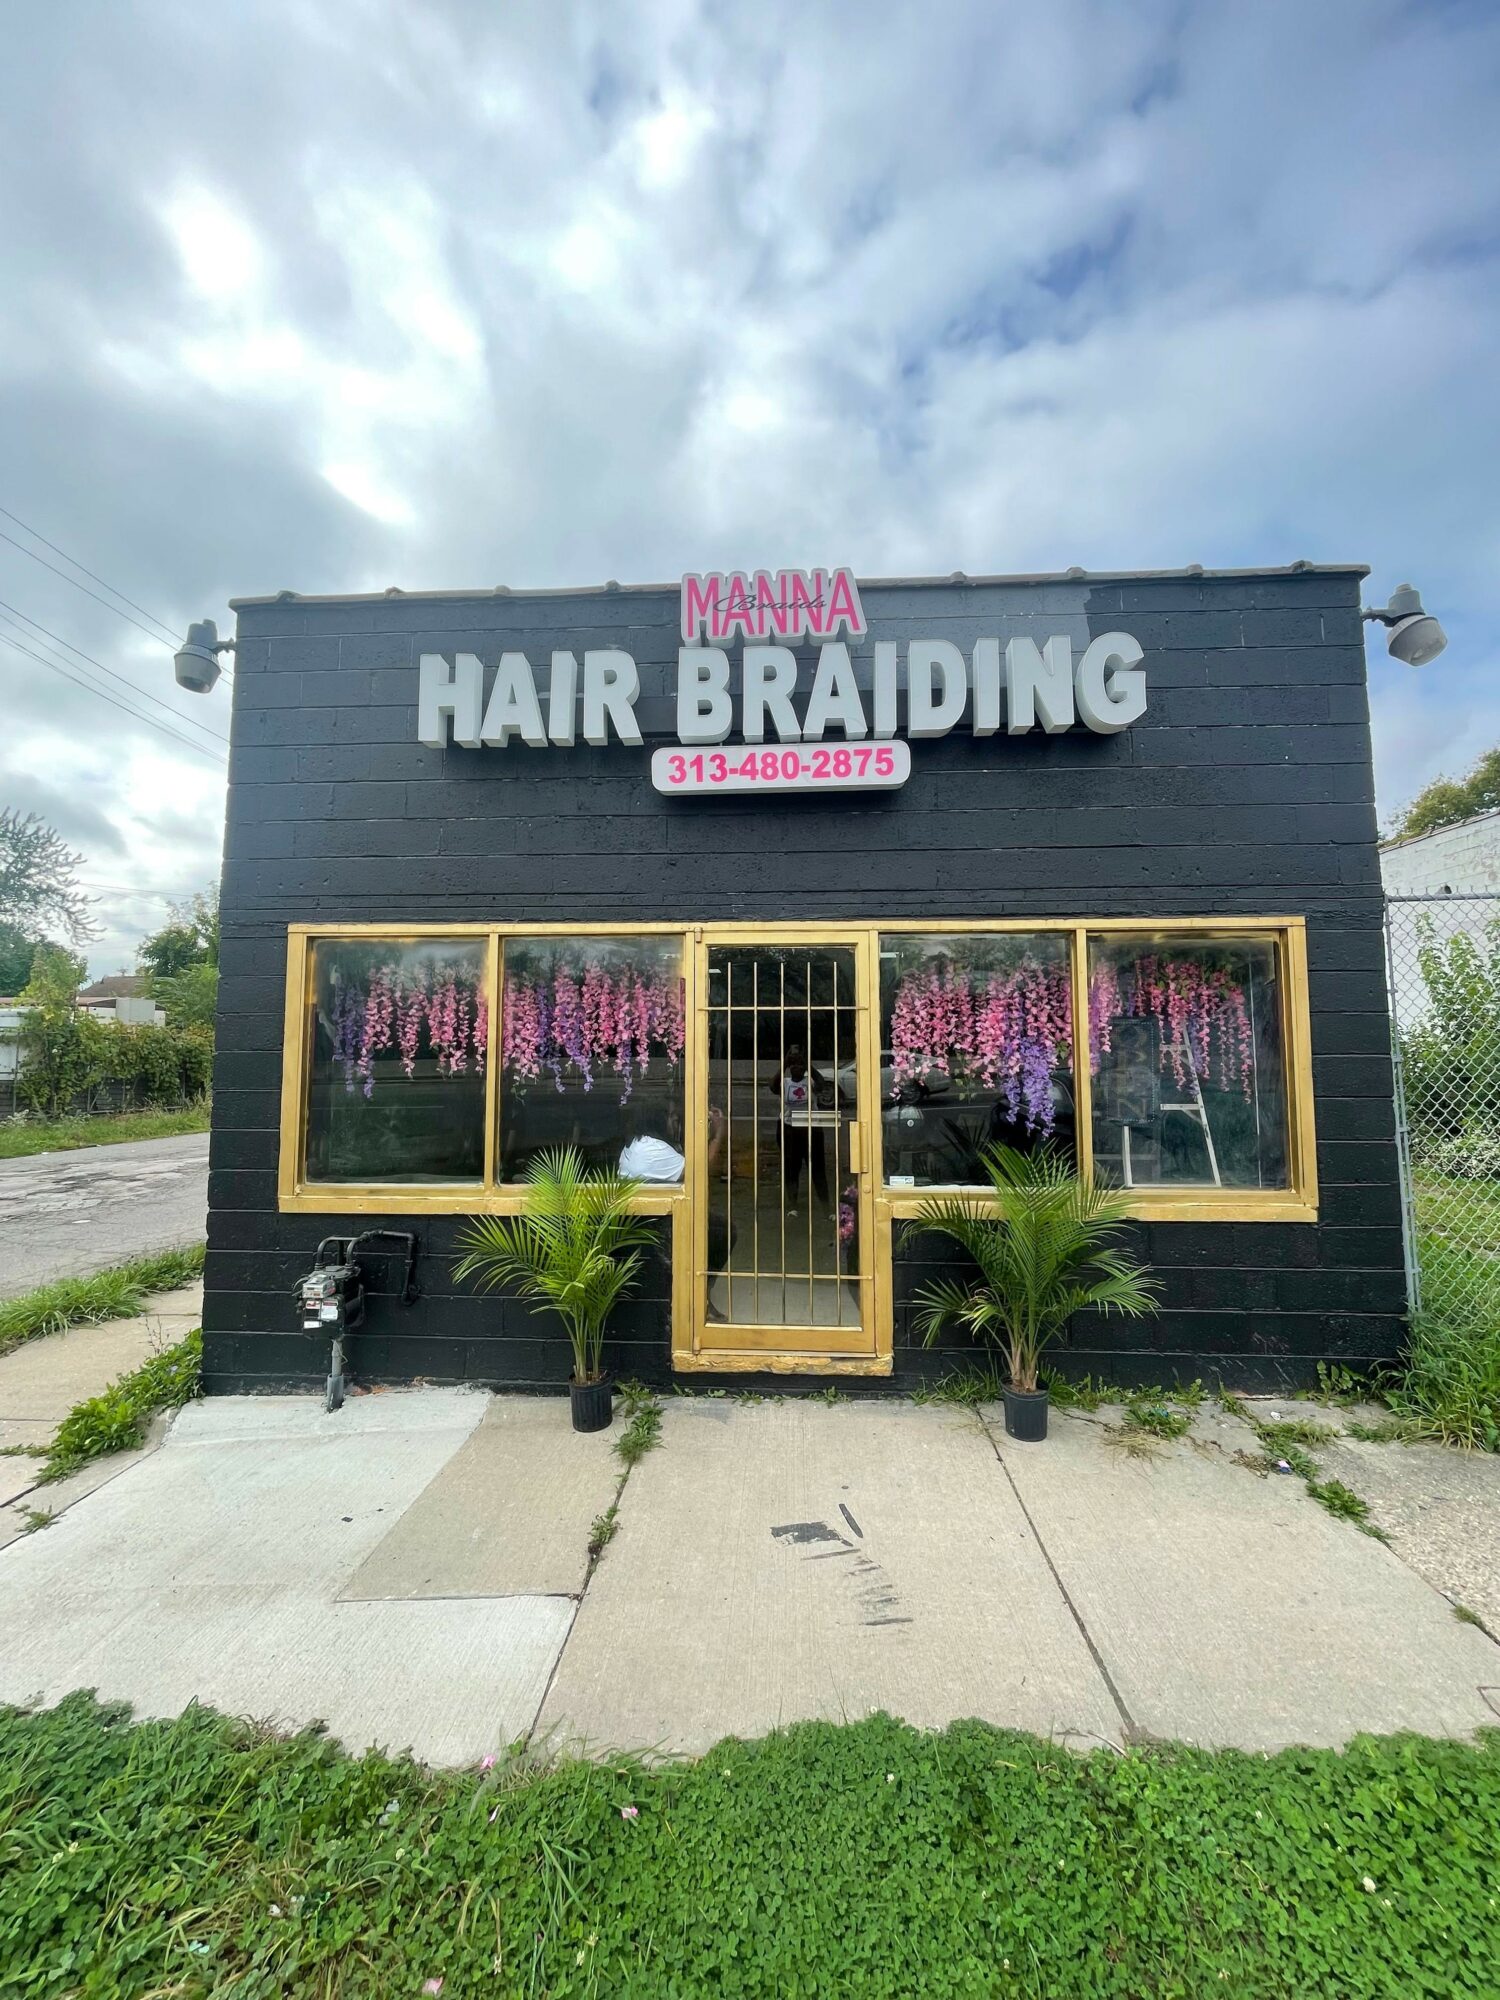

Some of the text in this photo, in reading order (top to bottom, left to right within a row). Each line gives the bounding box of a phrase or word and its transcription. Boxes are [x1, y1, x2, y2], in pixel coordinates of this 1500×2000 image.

[686, 571, 861, 638] MANNA
[713, 594, 828, 612] Braids
[418, 632, 1147, 748] HAIR BRAIDING
[668, 748, 895, 784] 313-480-2875
